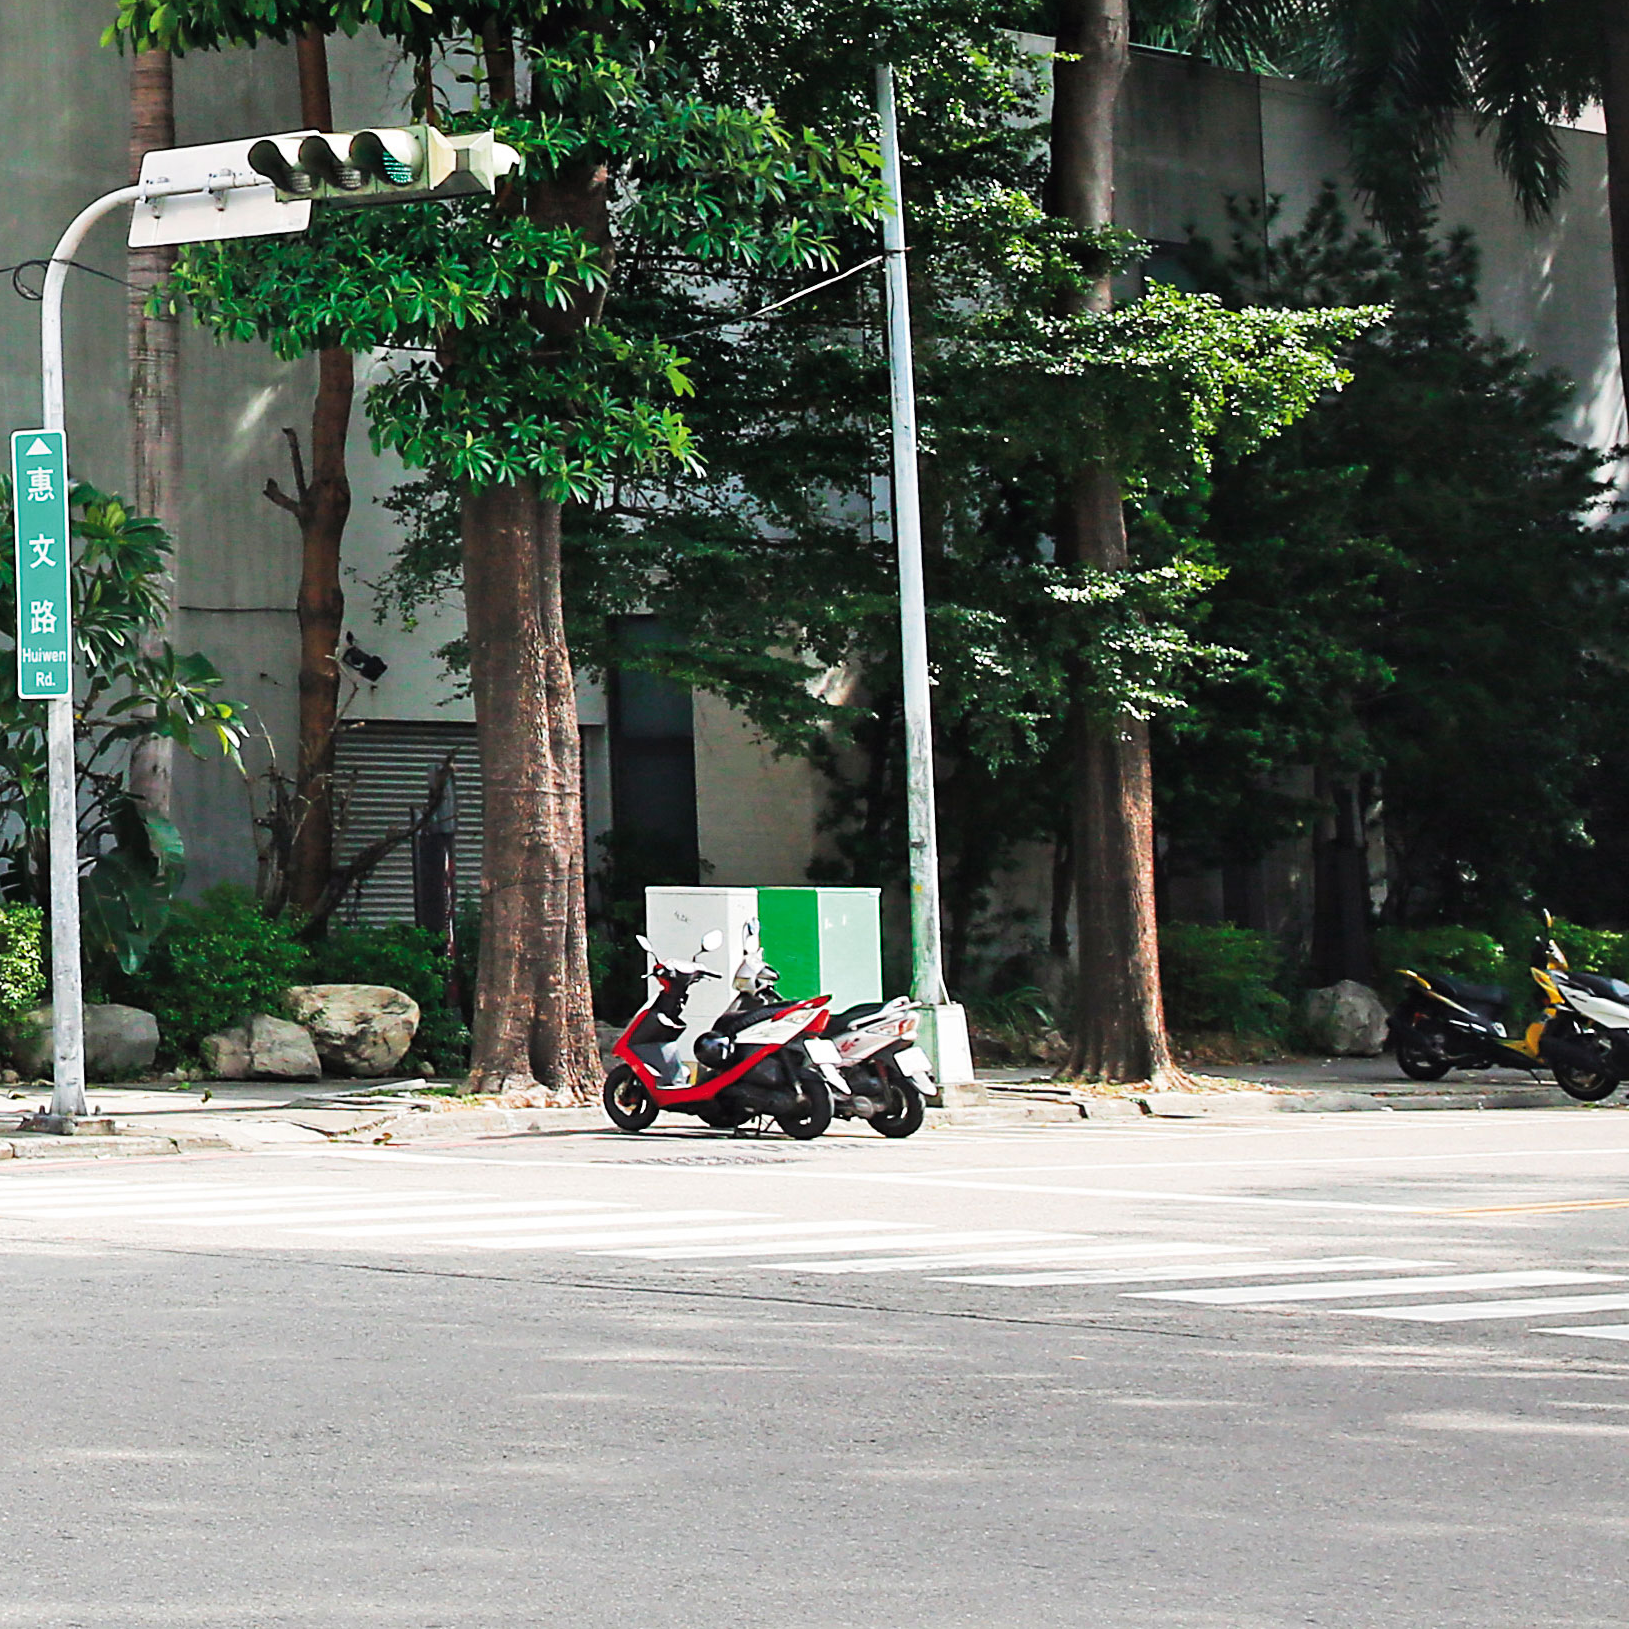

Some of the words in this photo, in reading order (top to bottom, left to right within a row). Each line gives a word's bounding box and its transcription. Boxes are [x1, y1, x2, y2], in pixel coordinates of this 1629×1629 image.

[26, 466, 58, 635] 惠文路
[22, 647, 67, 664] Huiwen
[35, 671, 56, 687] Rd.
